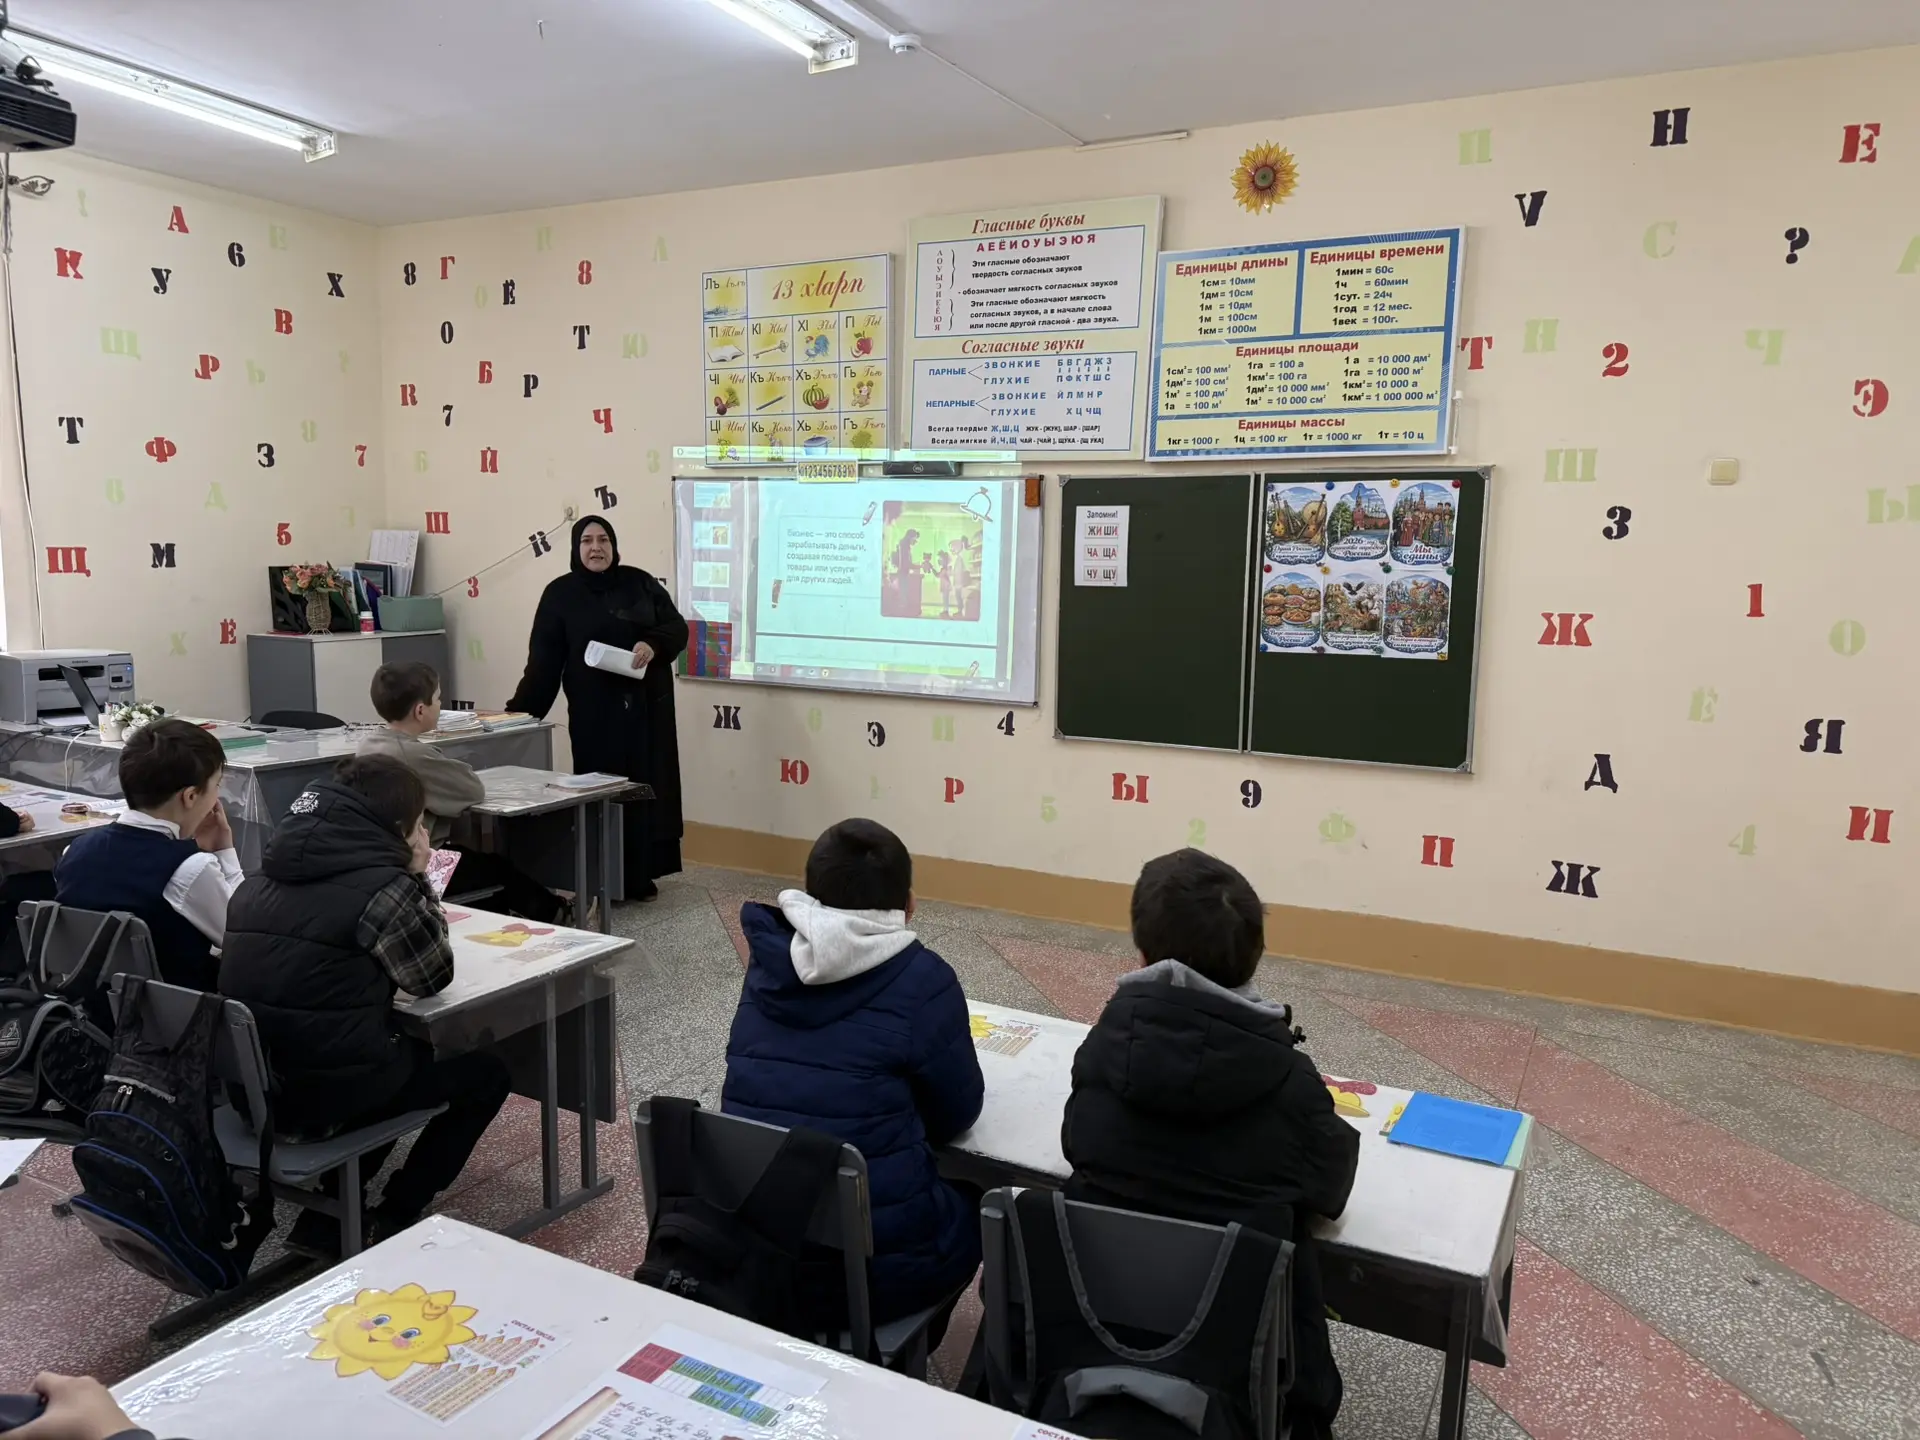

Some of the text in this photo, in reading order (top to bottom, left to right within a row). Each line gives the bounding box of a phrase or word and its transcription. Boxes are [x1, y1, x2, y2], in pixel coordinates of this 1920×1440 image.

[1649, 107, 1691, 147] Н
[1838, 123, 1881, 164] Е
[167, 205, 189, 234] А
[972, 213, 1085, 234] Гласные буквы
[1641, 220, 1678, 259] С
[1784, 227, 1810, 265] ?
[54, 247, 84, 280] К
[227, 241, 246, 268] 6
[440, 255, 455, 280] Г
[987, 258, 1020, 267] гласные
[1022, 254, 1070, 264] обозначают
[1175, 257, 1289, 277] Единицы длины
[1310, 244, 1445, 265] Единицы времени
[150, 267, 172, 295] У
[326, 272, 345, 298] Х
[403, 261, 417, 286] 8
[578, 260, 592, 285] 8
[972, 265, 1083, 279] твердость согласных звуков
[772, 279, 794, 300] 13
[962, 280, 1118, 295] обозначает мягкость согласных звуков
[986, 298, 1018, 307] гласные
[1020, 295, 1068, 305] обозначают
[1070, 293, 1106, 302] мягкость
[274, 308, 293, 335] В
[970, 310, 1011, 318] согласных
[1057, 306, 1085, 314] начале
[1010, 318, 1036, 328] другой
[1038, 317, 1071, 326] гласной
[1076, 317, 1092, 325] два
[572, 324, 591, 350] Т
[961, 338, 1085, 355] Согласные звуки
[1524, 318, 1559, 352] Н
[1745, 329, 1784, 365] Ч
[1236, 342, 1359, 358] Единицы площади
[1460, 336, 1493, 371] Т
[1602, 342, 1629, 378] 2
[478, 360, 493, 384] Б
[928, 368, 967, 376] ПАРНЫЕ
[523, 373, 539, 398] Р
[1852, 378, 1889, 418] Э
[442, 404, 454, 427] 7
[926, 400, 976, 408] НЕПАРНЫЕ
[58, 416, 84, 445] Т
[592, 407, 614, 434] Ч
[1238, 418, 1345, 431] Единицы массы
[144, 436, 177, 464] Ф
[1192, 437, 1213, 445] 1000
[1259, 435, 1276, 443] 100
[355, 444, 367, 467] 7
[1546, 448, 1597, 483] Ш
[593, 484, 618, 511] Ъ
[425, 511, 451, 535] Ш
[1086, 510, 1118, 519] Запомни!
[276, 522, 292, 546] 5
[838, 531, 865, 539] способ
[1088, 526, 1118, 536] ЖИ ШИ
[1343, 537, 1363, 545] 2026
[149, 542, 177, 569] М
[1087, 547, 1117, 559] ЧА ЩА
[1403, 553, 1441, 565] едины
[1410, 543, 1433, 554] Мы
[45, 546, 91, 578] Щ
[1087, 569, 1117, 581] ЧУ ЩУ
[1746, 583, 1765, 618] 1
[1537, 612, 1594, 647] Ж
[712, 704, 742, 731] Ж
[996, 710, 1016, 738] 4
[867, 721, 886, 748] Э
[1799, 718, 1846, 755] Я
[780, 759, 810, 785] Ю
[1584, 753, 1619, 794] Д
[944, 777, 965, 804] Р
[1111, 772, 1150, 804] Ы
[1239, 779, 1262, 809] 9
[1845, 806, 1894, 844] И
[1420, 834, 1456, 868] П
[1545, 859, 1601, 899] Ж
